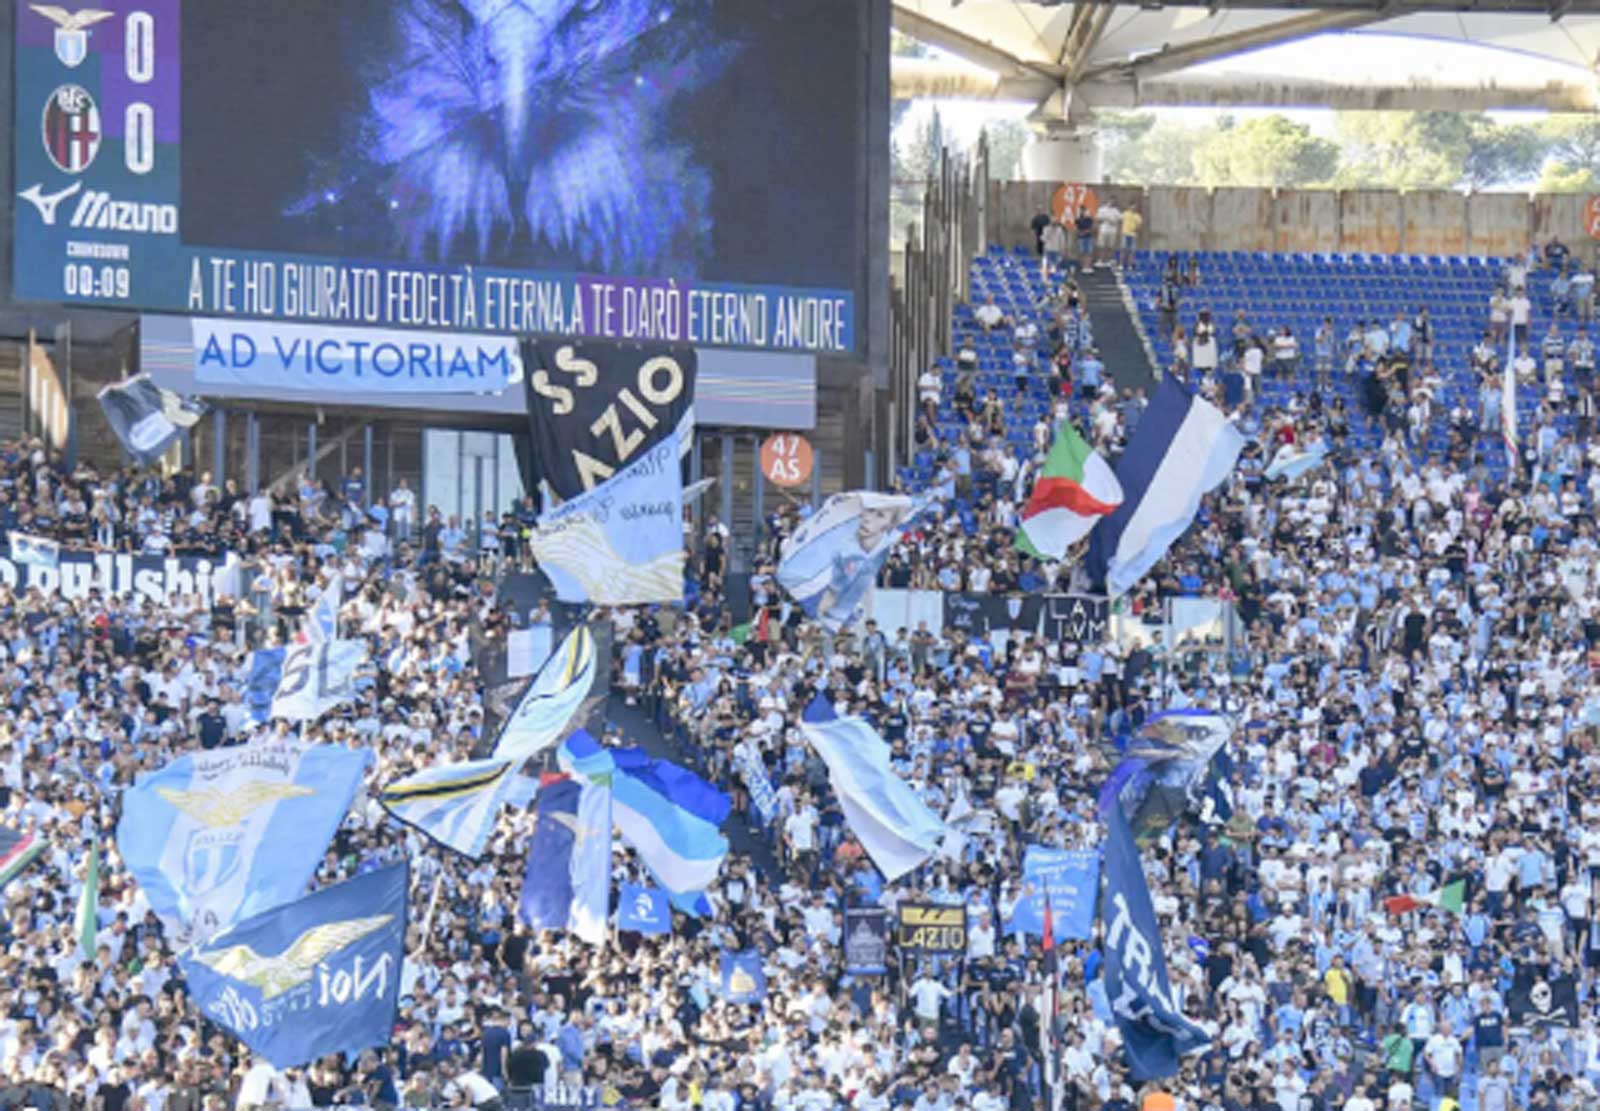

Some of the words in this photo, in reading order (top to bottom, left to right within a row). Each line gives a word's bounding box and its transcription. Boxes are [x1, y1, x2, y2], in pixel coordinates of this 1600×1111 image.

[125, 11, 154, 83] 0
[125, 102, 154, 174] 0
[188, 257, 204, 310] A
[211, 259, 237, 313] TE
[243, 262, 276, 315] HO
[283, 264, 379, 322] GIURATO
[386, 266, 477, 328] FEDELTÀ
[591, 283, 616, 338] TE
[622, 279, 681, 341] DARÒ
[687, 290, 767, 346] ETERNO
[772, 298, 846, 350] AMORE
[199, 334, 258, 369] AD
[272, 337, 509, 378] VICTORIAM
[531, 346, 598, 414] SS
[560, 356, 684, 497] AZIO
[772, 433, 800, 453] 47
[769, 458, 801, 481] AS
[899, 925, 966, 950] LAZIO
